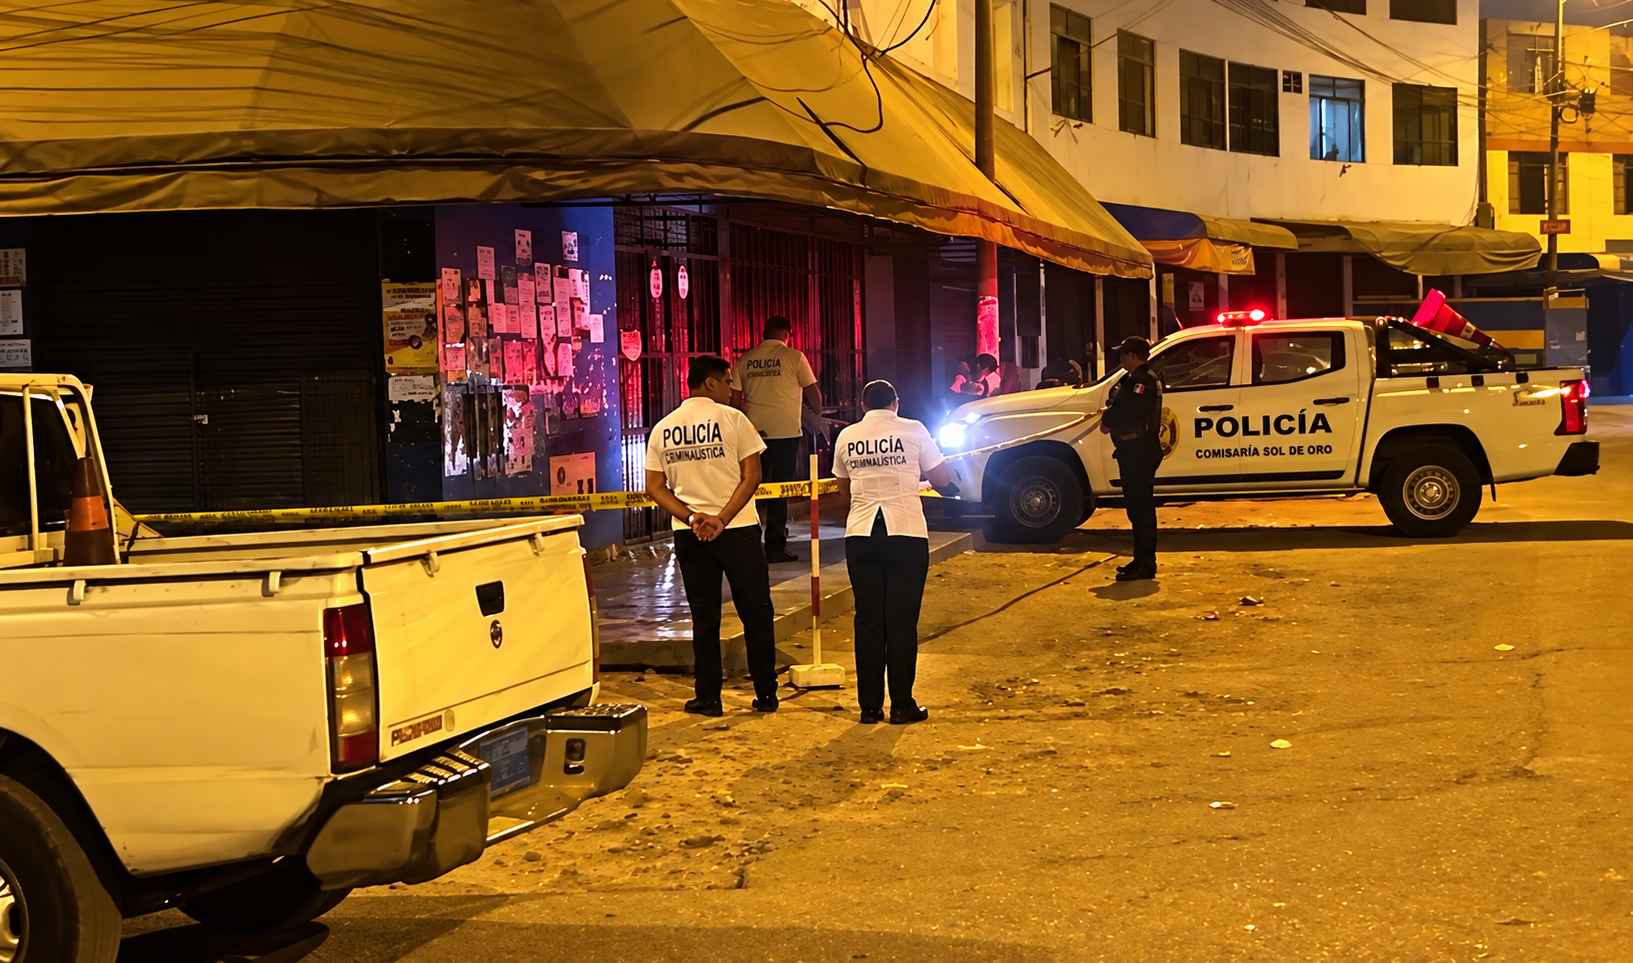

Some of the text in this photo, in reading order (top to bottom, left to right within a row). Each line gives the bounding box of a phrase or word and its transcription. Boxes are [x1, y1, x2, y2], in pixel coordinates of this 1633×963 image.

[746, 356, 781, 370] POLICÍA
[663, 418, 723, 448] POLICÍA
[1194, 408, 1333, 438] POLICÍA
[847, 435, 905, 457] POLICÍA
[1195, 444, 1333, 459] COMISARÍA SOL DE ORO
